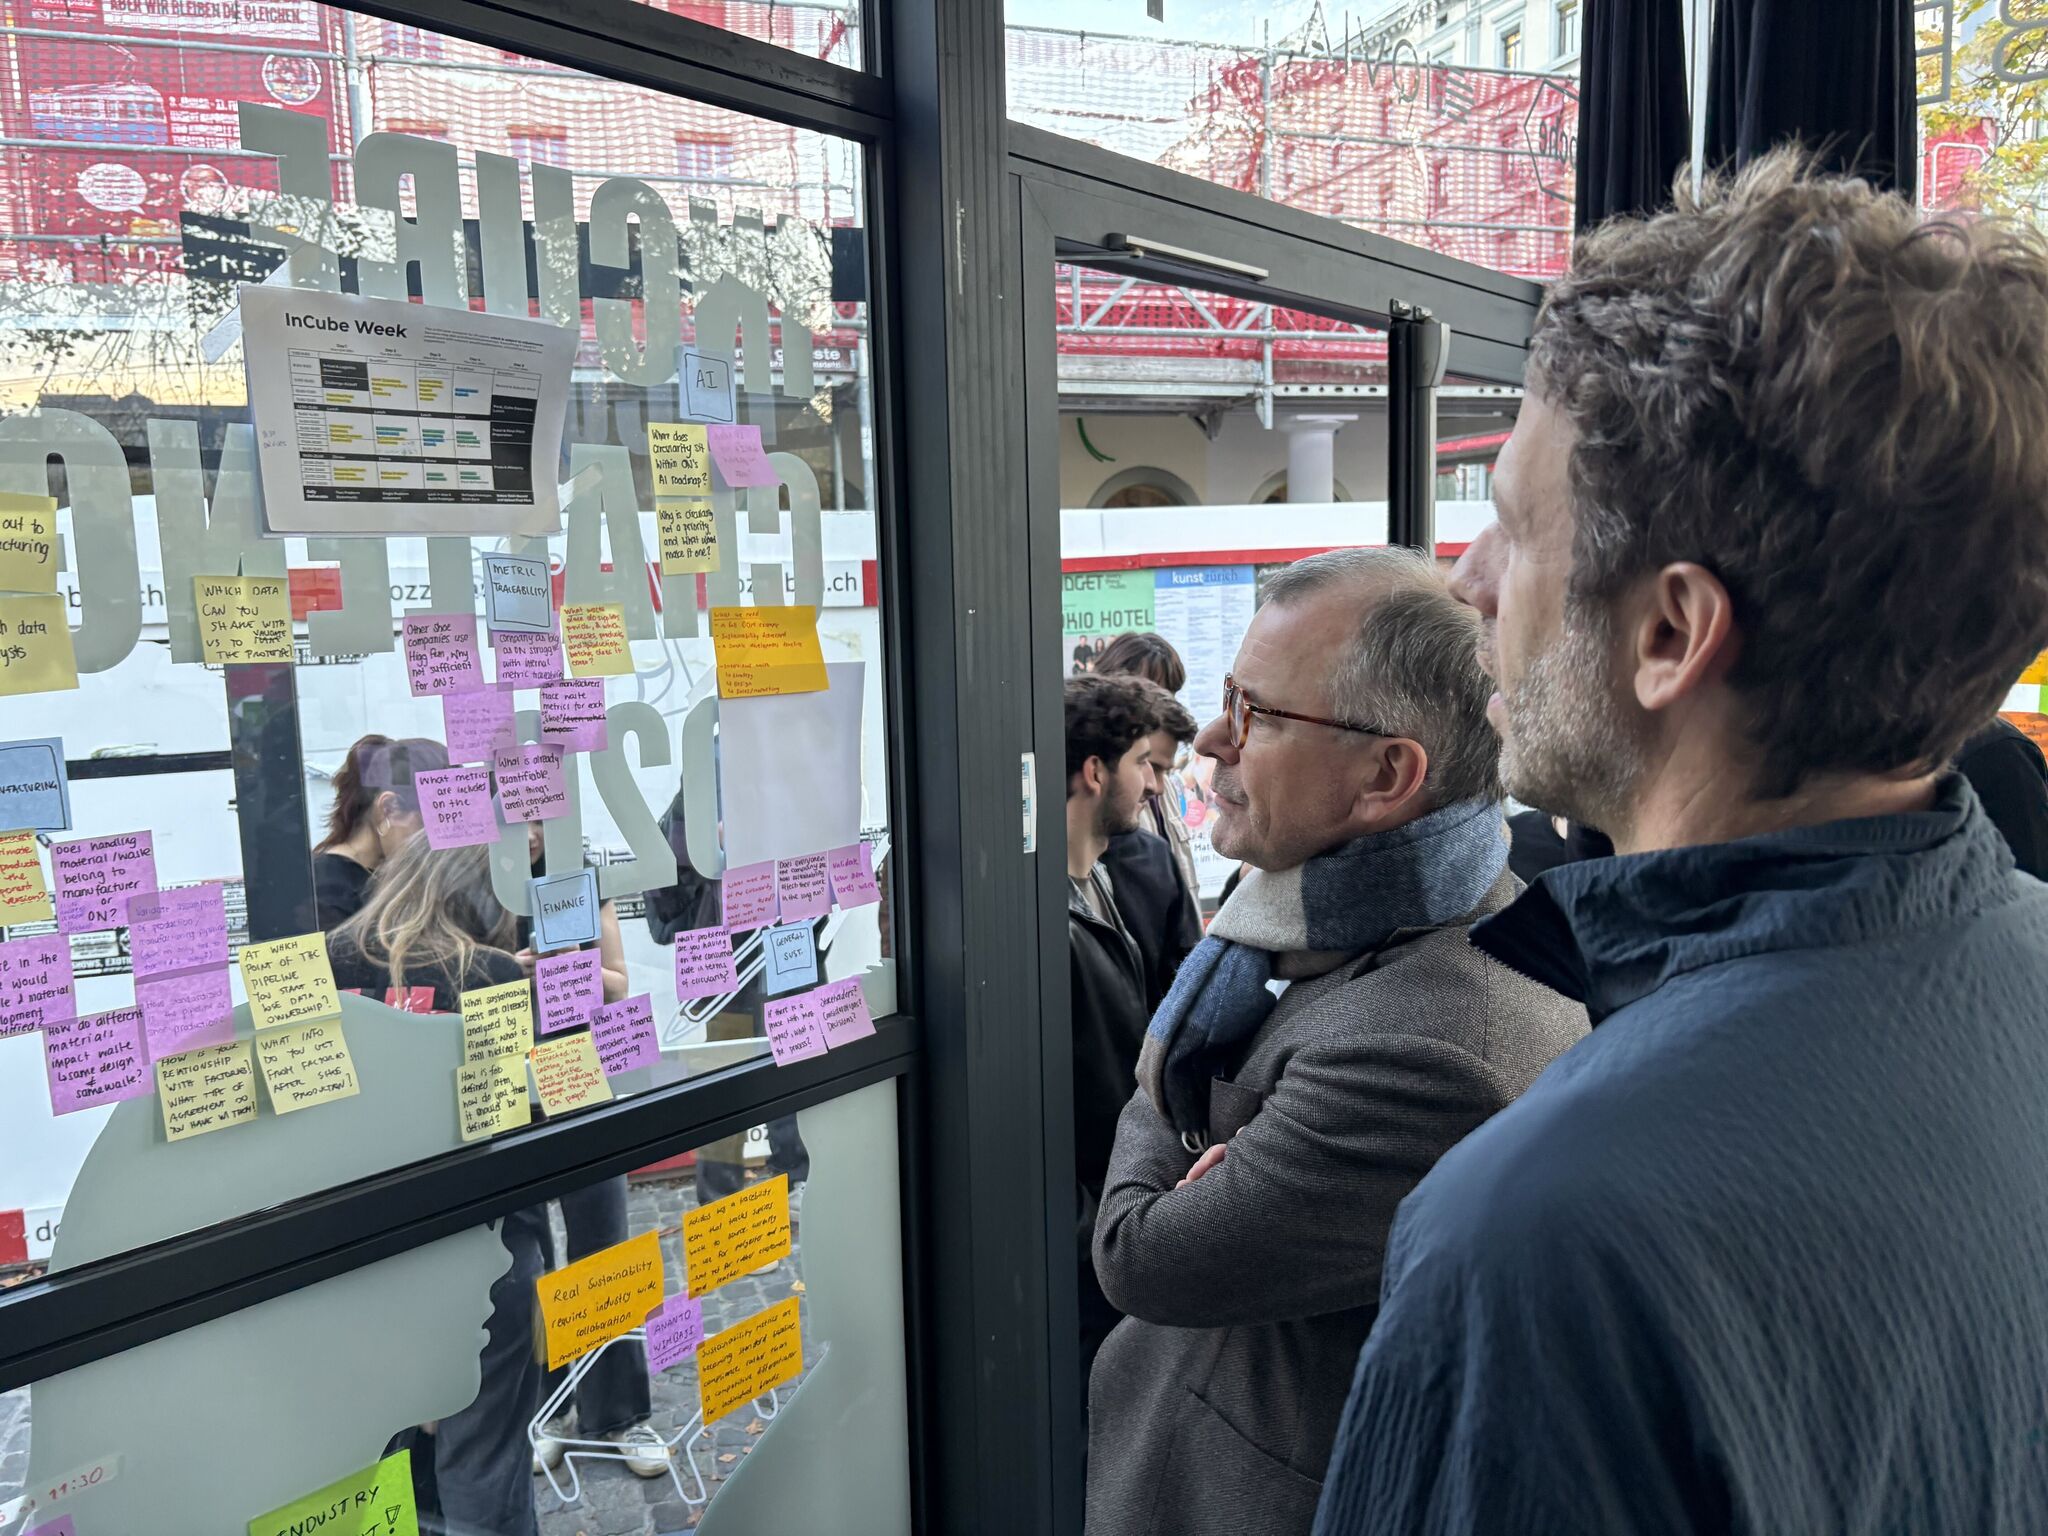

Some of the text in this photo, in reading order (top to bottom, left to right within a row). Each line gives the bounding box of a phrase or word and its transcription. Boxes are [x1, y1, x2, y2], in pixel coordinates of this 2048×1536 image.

[285, 312, 408, 338] InCube Week
[253, 586, 279, 596] DATA
[1100, 608, 1153, 629] HOTEL
[543, 895, 585, 914] FINANCE
[553, 1283, 581, 1303] Real
